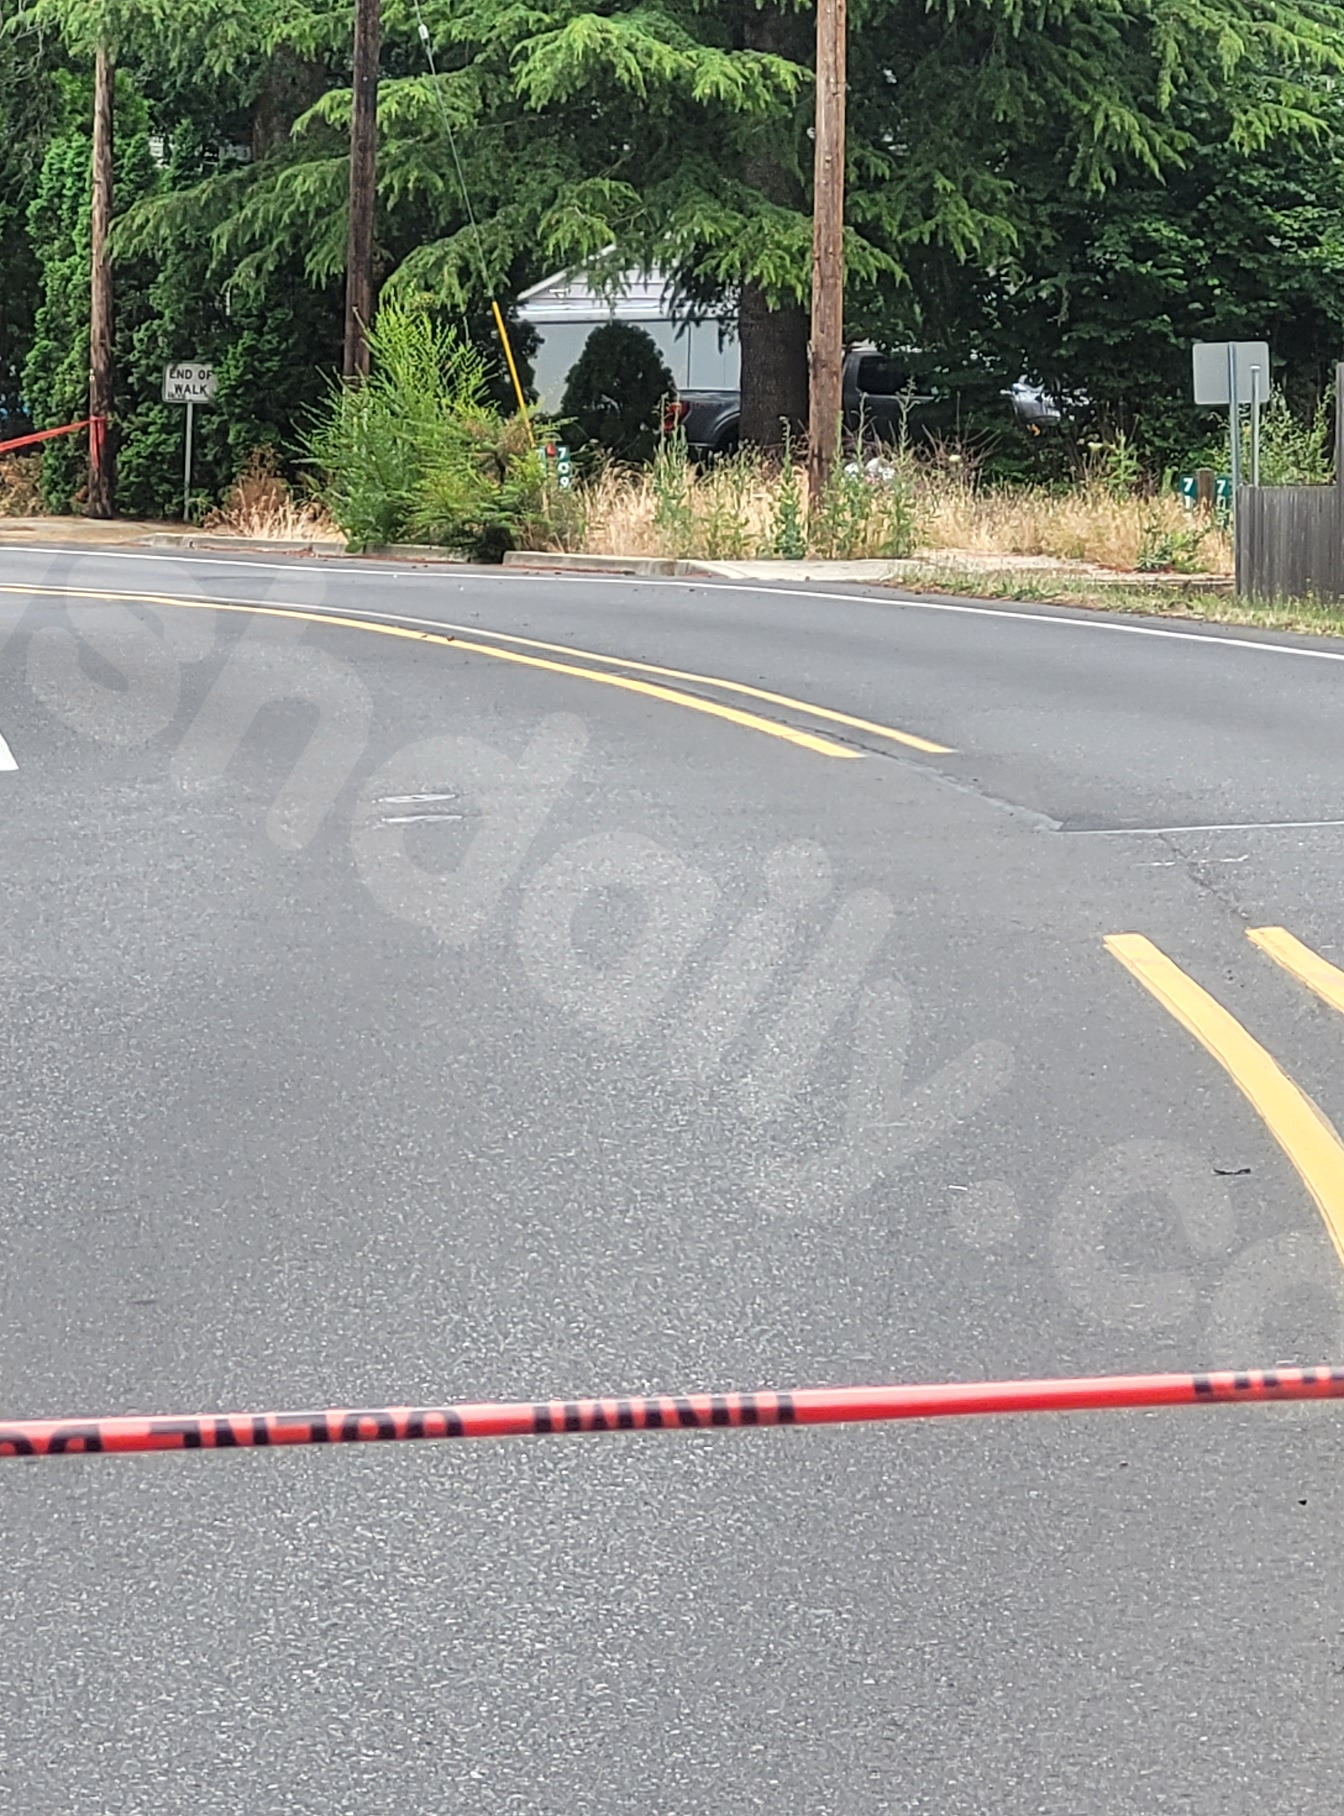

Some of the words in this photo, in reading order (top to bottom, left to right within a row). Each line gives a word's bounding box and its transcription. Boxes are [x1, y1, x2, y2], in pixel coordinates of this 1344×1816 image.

[169, 368, 193, 380] END
[198, 369, 214, 380] OF
[174, 383, 209, 396] WALK
